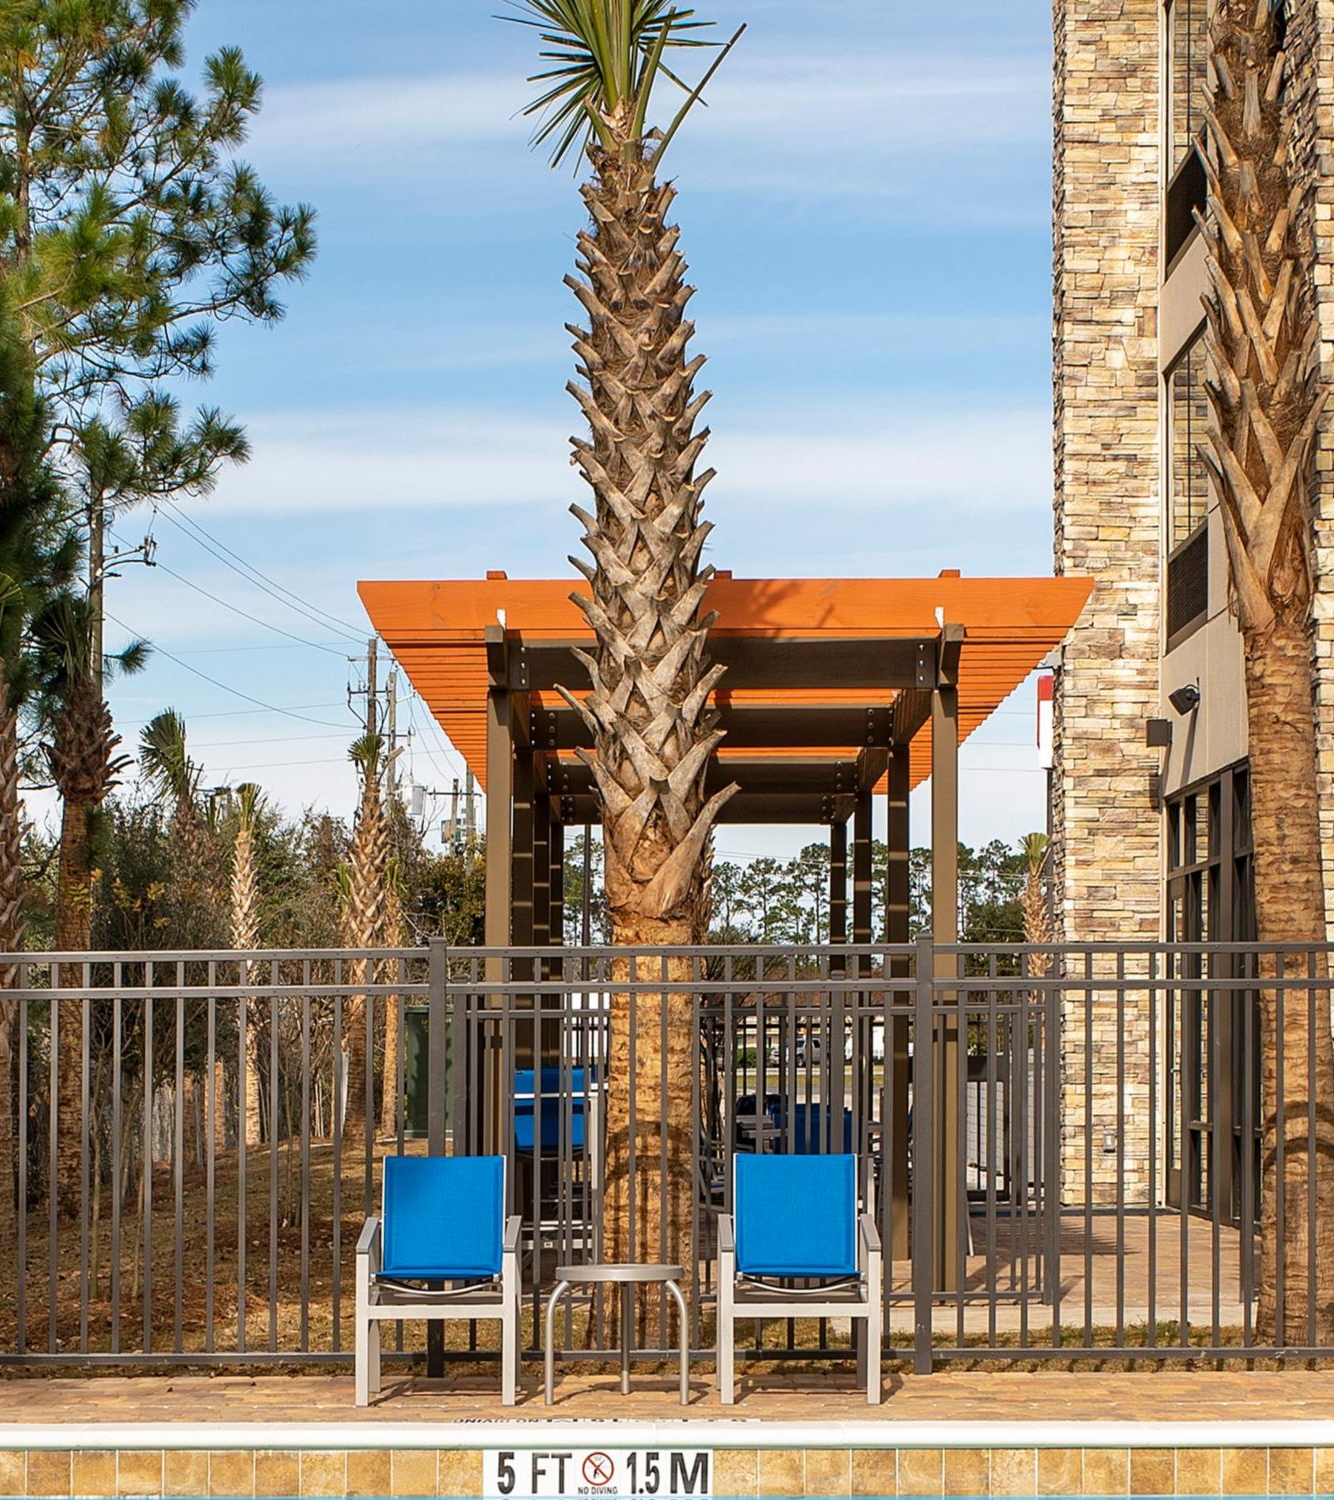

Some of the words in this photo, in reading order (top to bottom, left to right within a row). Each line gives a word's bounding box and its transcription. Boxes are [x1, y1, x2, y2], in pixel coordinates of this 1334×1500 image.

[497, 1451, 516, 1495] 5
[531, 1452, 573, 1494] FT
[626, 1451, 660, 1495] 1.5
[670, 1452, 709, 1494] M
[577, 1486, 590, 1495] NO
[591, 1486, 618, 1495] DIVING
